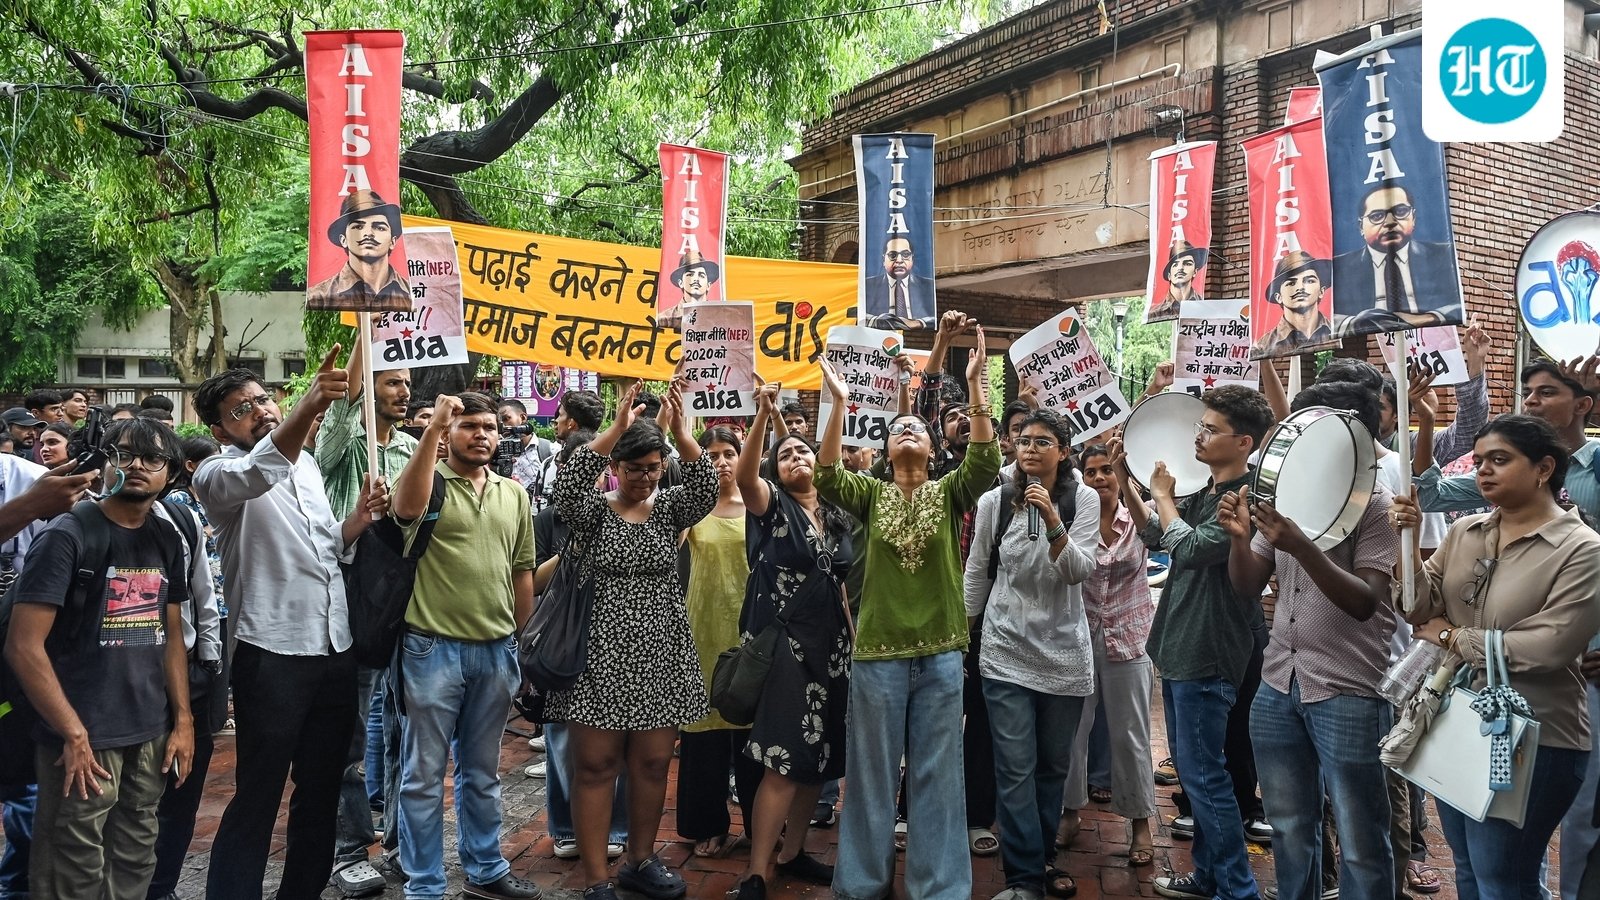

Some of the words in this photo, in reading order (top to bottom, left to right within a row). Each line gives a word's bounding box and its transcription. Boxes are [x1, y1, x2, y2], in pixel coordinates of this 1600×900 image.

[338, 43, 373, 197] AISA
[1357, 49, 1406, 184] AISA
[885, 138, 910, 234] AISA
[1169, 150, 1194, 249] AISA
[1272, 131, 1302, 261] AISA
[678, 152, 702, 255] AISA
[940, 188, 1044, 228] UNIVERSITY
[464, 242, 542, 293] पढ़ाई
[549, 256, 634, 304] करने
[550, 314, 665, 366] बदलने
[685, 328, 707, 344] शिक्षा
[759, 301, 858, 364] ais
[1179, 320, 1217, 340] राष्ट्रीय
[383, 335, 449, 362] aisa
[827, 345, 861, 367] राष्ट्रीय
[864, 349, 892, 370] परीक्षा
[1051, 337, 1081, 360] परीक्षा
[1195, 341, 1229, 358] एजेंसी
[1229, 344, 1249, 361] (NT
[1186, 360, 1201, 373] को
[692, 390, 743, 411] aisa
[1044, 393, 1058, 408] को
[842, 414, 887, 440] isa
